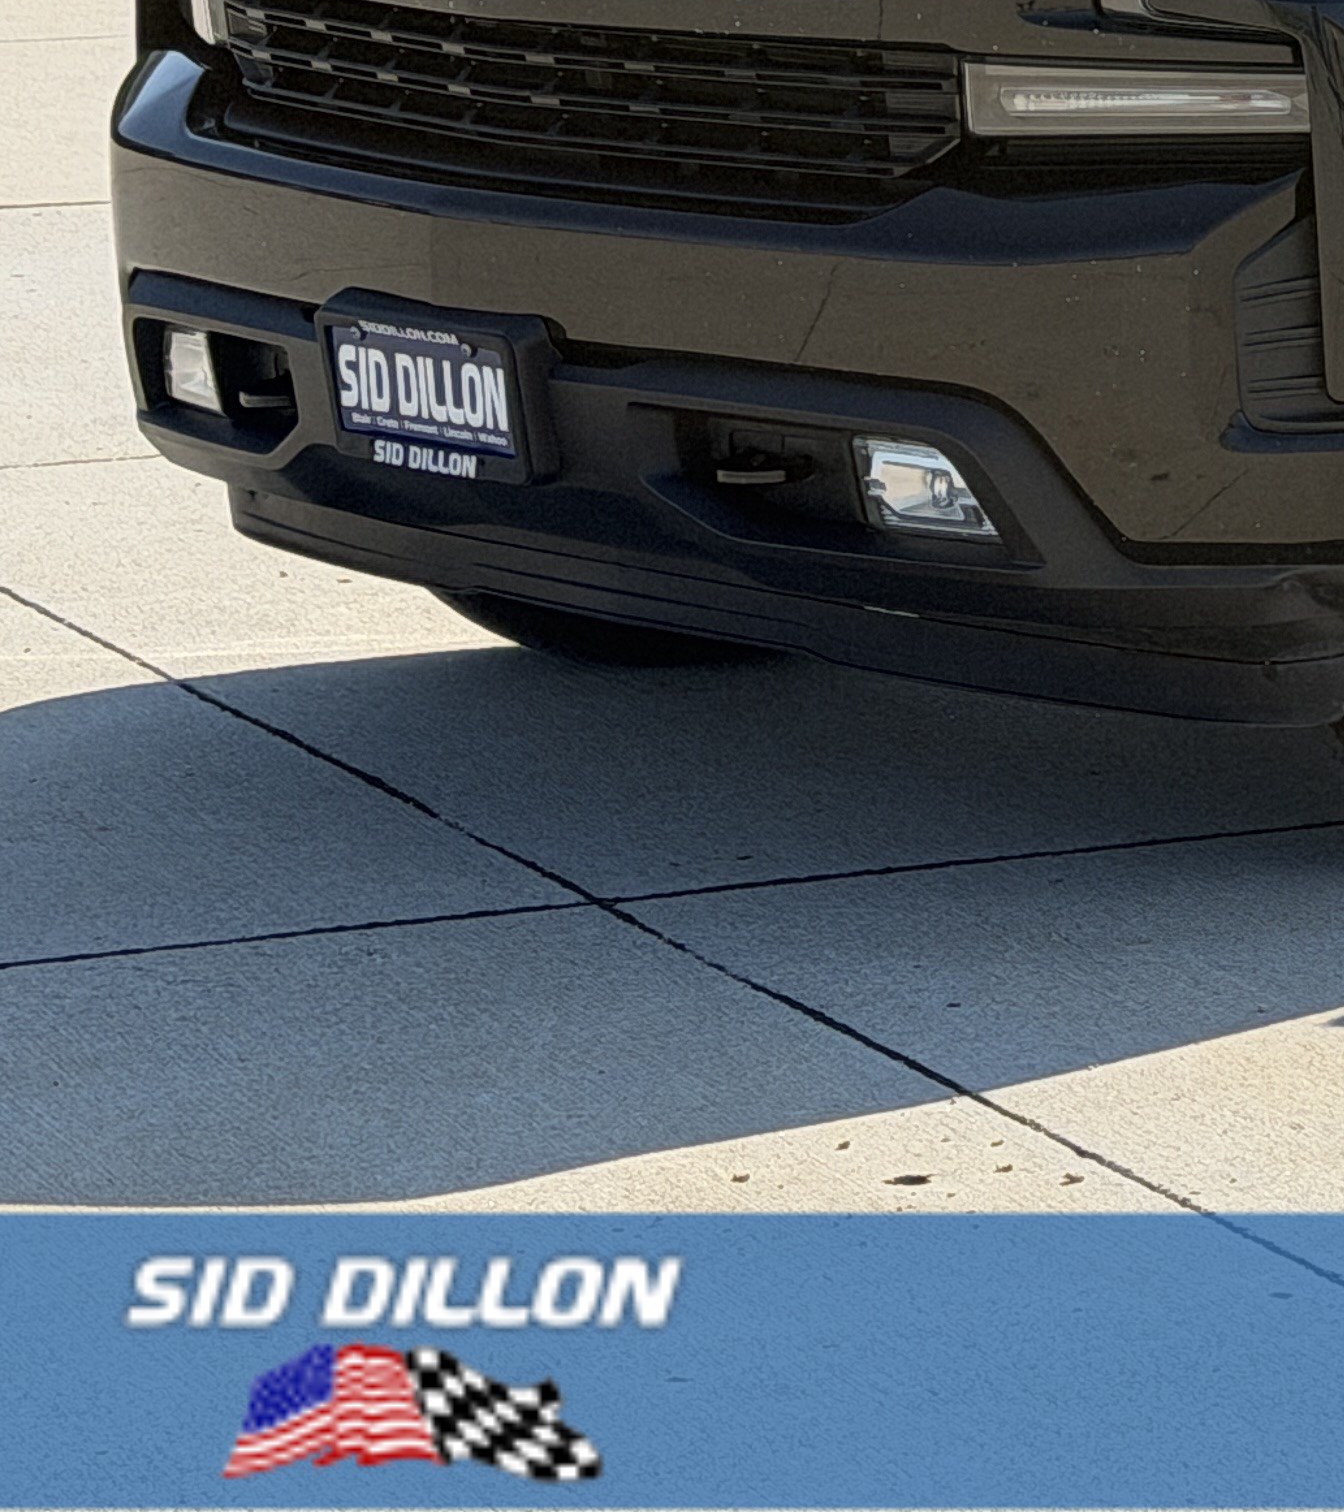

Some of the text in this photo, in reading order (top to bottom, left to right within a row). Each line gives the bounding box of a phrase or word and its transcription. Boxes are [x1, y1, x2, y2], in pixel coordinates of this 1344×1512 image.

[338, 343, 510, 432] SID DILLON
[372, 439, 478, 479] SID DILLON
